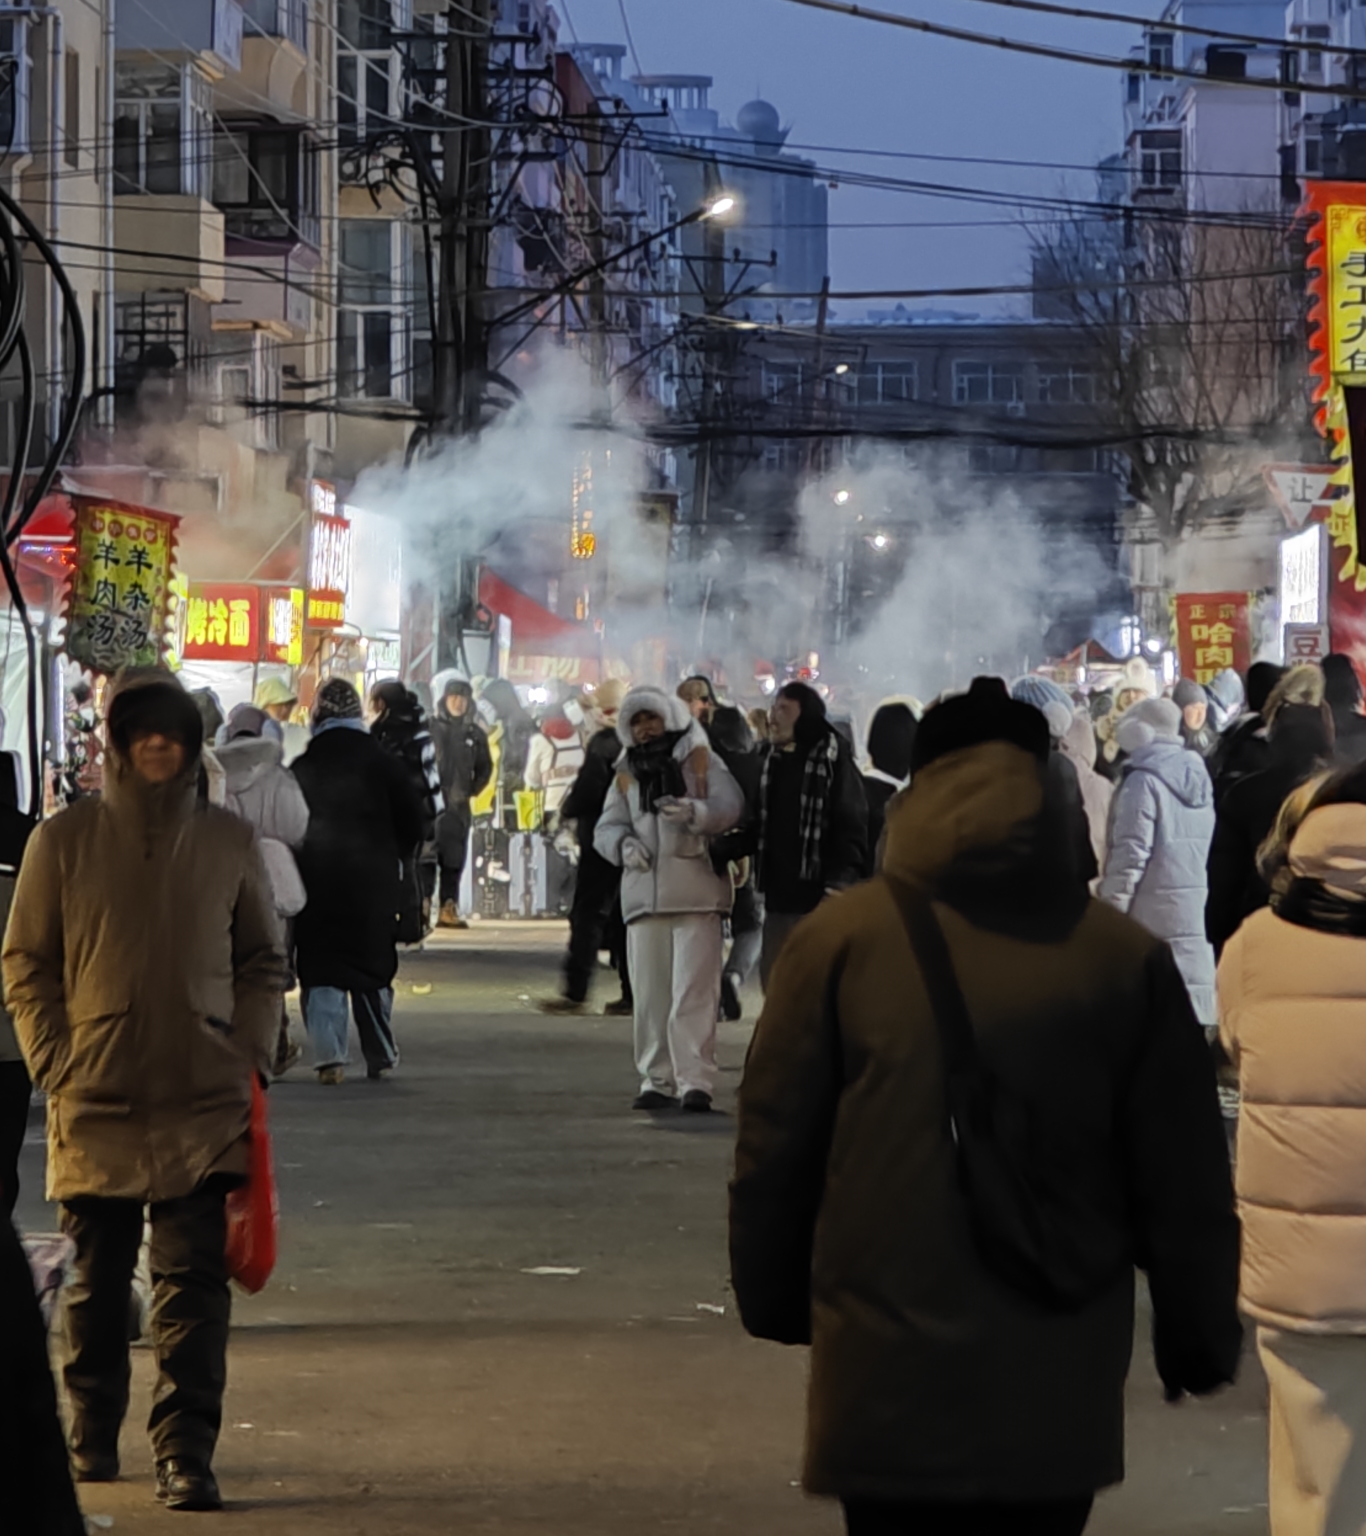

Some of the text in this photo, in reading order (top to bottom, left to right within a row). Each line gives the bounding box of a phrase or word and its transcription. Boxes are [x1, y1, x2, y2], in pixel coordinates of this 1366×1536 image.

[1290, 476, 1314, 504] 让
[86, 538, 122, 646] 羊肉汤
[120, 543, 155, 651] 羊杂汤
[186, 597, 251, 647] 烤冷面
